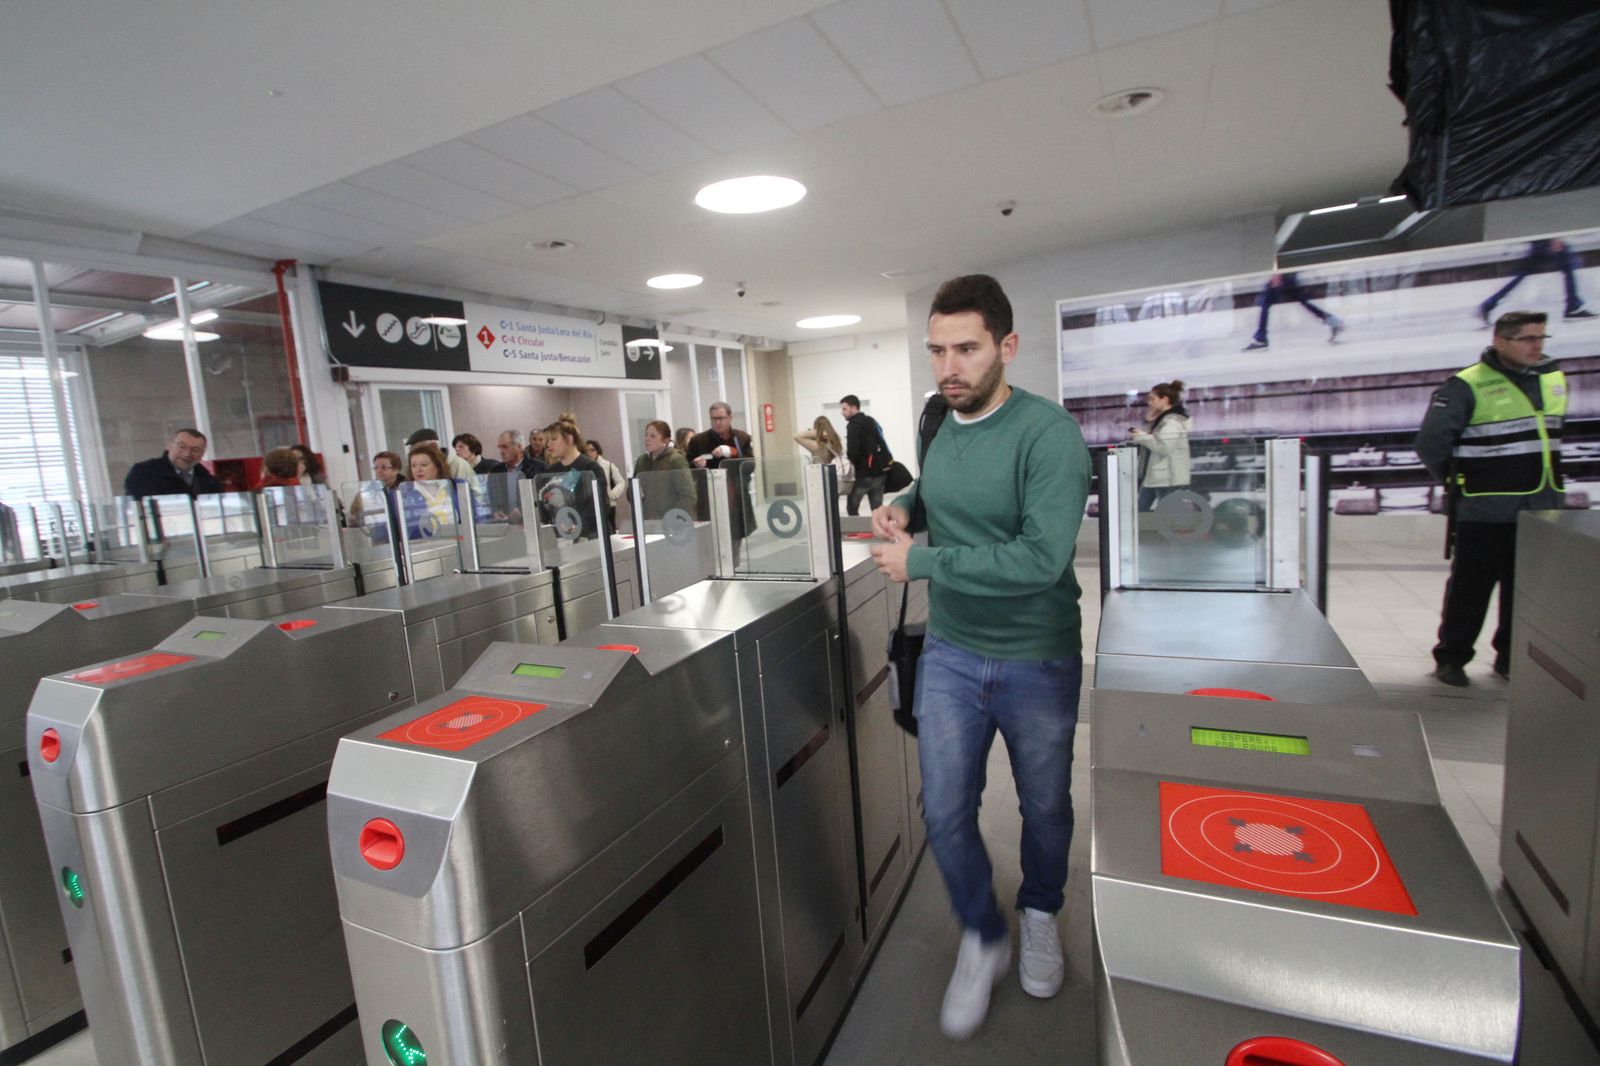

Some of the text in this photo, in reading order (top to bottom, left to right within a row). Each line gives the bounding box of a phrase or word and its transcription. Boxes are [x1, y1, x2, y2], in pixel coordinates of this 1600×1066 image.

[499, 320, 514, 331] C-1
[515, 321, 537, 333] Santa
[571, 329, 581, 338] del
[482, 330, 490, 345] 1
[501, 334, 545, 347] C-4 Circular
[503, 349, 517, 359] C-5
[518, 350, 539, 360] Santa
